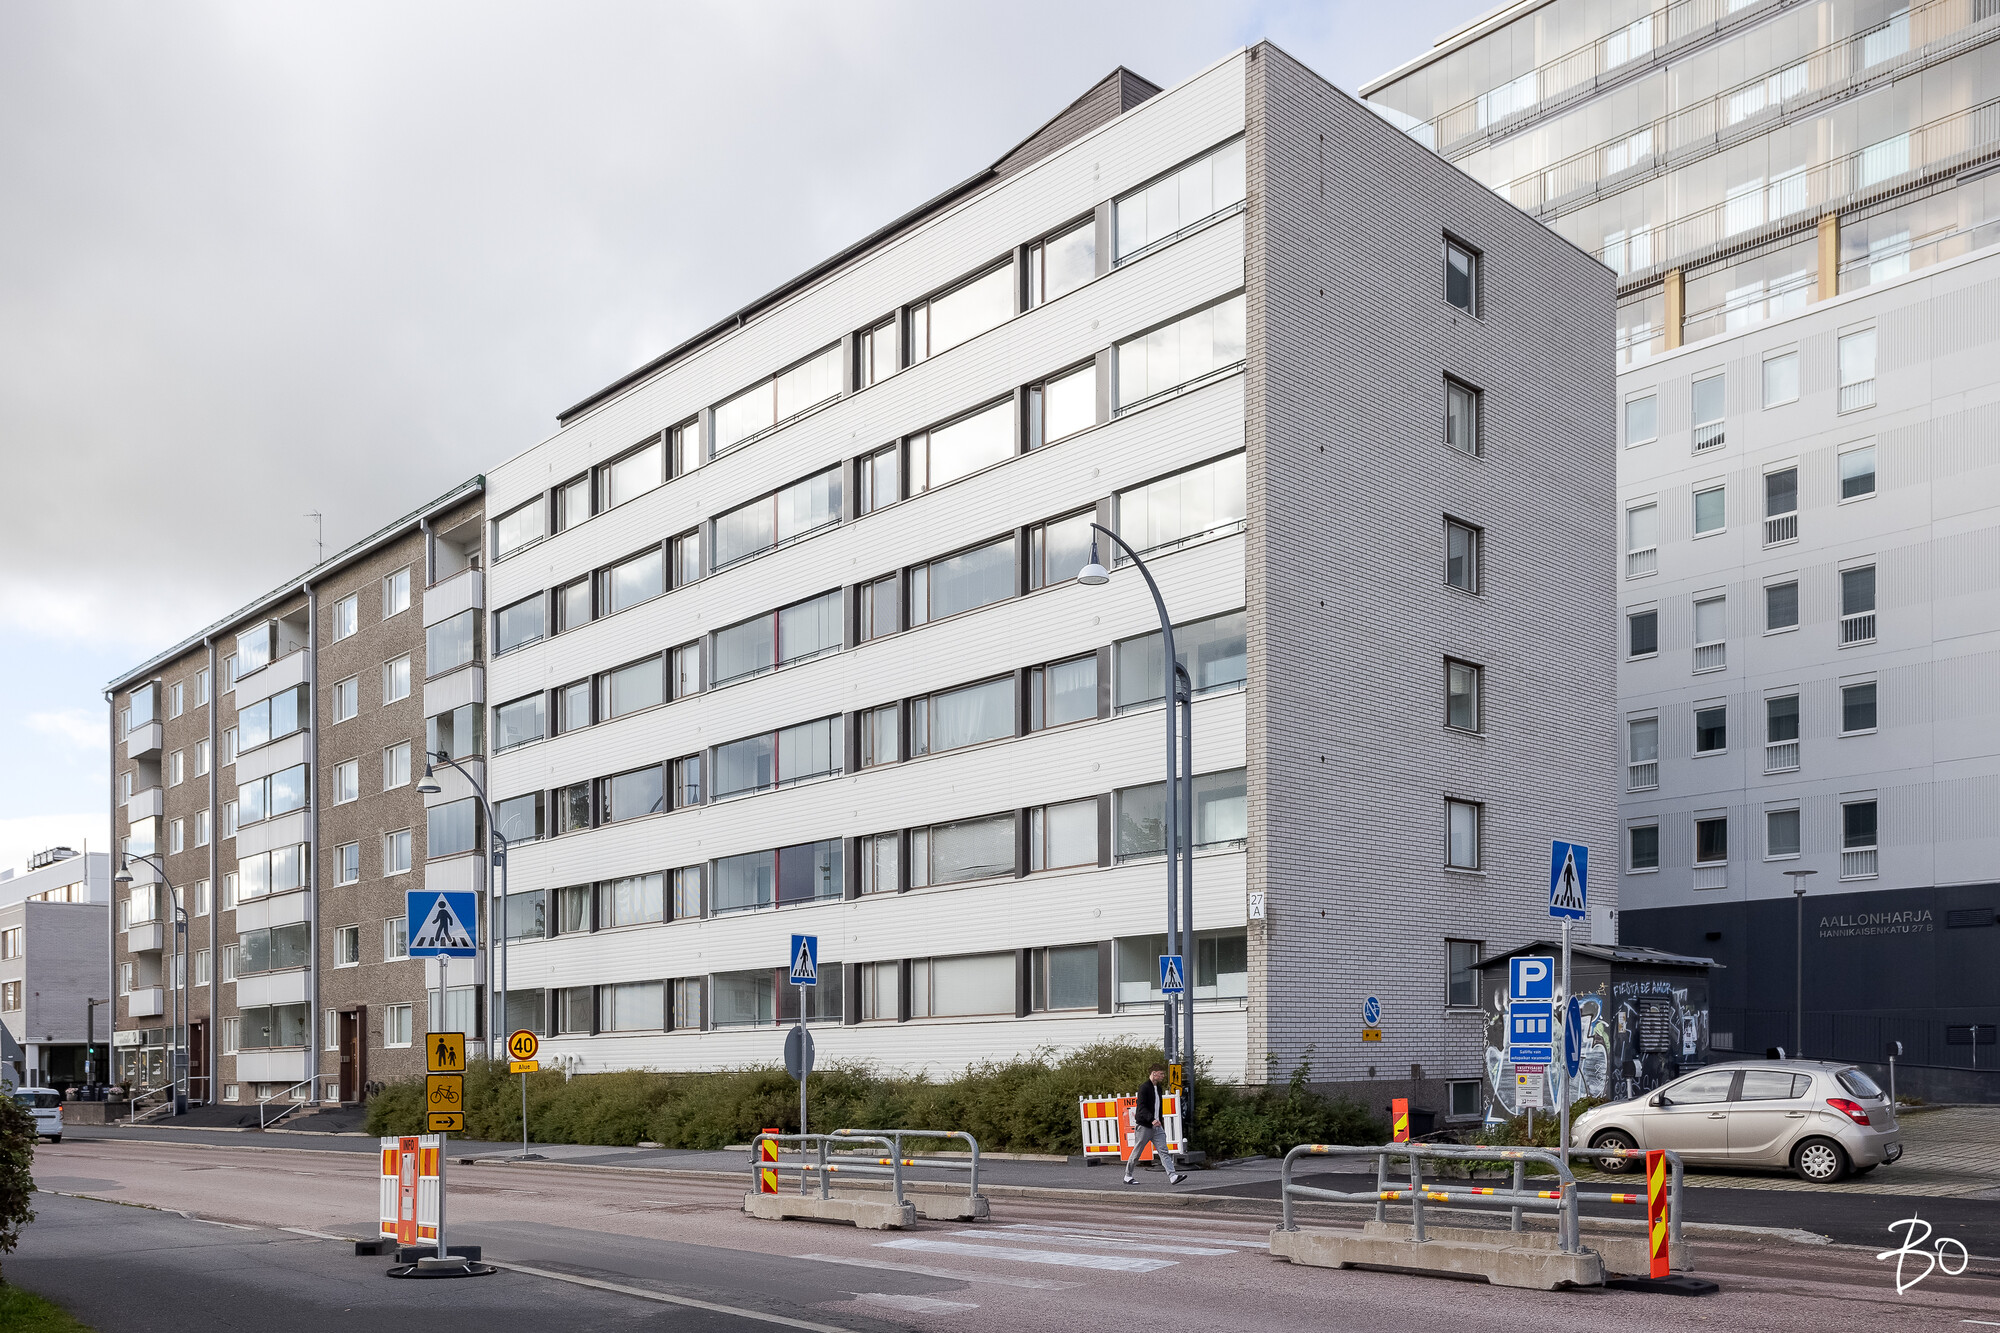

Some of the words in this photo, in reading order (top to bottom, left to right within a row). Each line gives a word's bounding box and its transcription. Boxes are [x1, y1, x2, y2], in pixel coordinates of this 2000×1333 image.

[1251, 894, 1263, 906] 27
[1253, 906, 1261, 917] A
[1819, 909, 1933, 928] AALLONHARJA
[1819, 925, 1910, 938] HANNIKAISENKATU
[1911, 924, 1924, 933] 27
[1926, 923, 1934, 932] B
[1518, 960, 1548, 997] P
[1613, 981, 1640, 997] FIESTA
[1640, 982, 1651, 994] DE
[1651, 980, 1672, 995] AMOR
[513, 1037, 533, 1054] 40
[1123, 1098, 1138, 1106] INF
[402, 1138, 414, 1151] INFO
